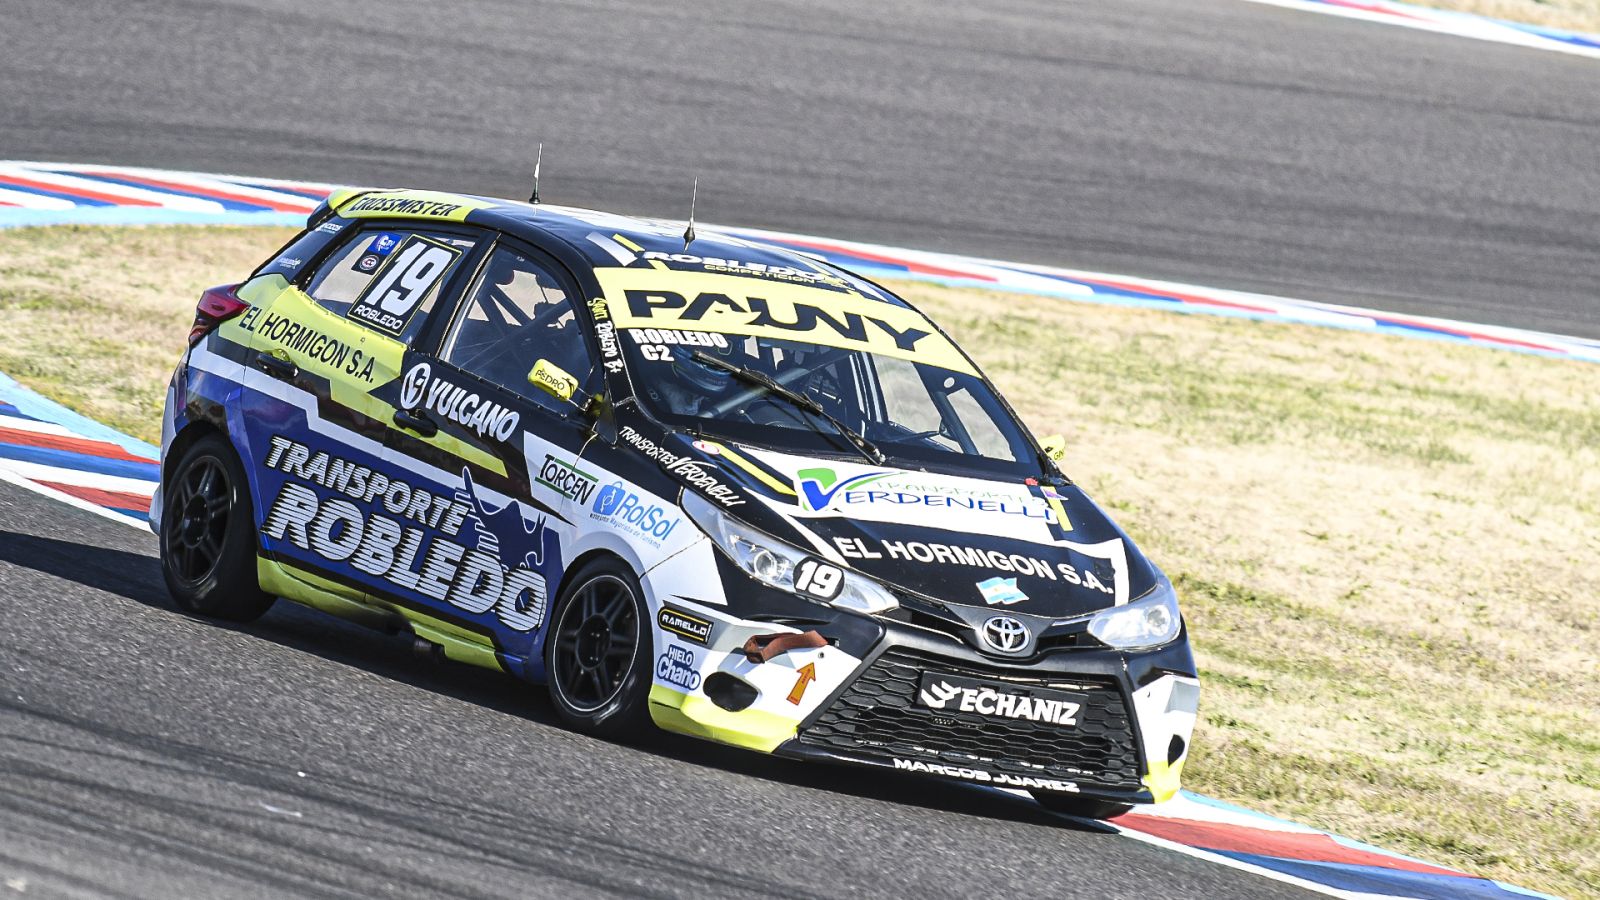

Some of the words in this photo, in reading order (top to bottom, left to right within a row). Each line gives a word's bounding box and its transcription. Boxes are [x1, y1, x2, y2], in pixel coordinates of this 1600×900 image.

[364, 241, 452, 316] 19
[643, 251, 826, 282] ROBLEDO
[704, 263, 816, 284] COMPETICION
[354, 304, 404, 329] ROBLEDO
[622, 288, 933, 352] PAUNY
[238, 306, 263, 332] EL
[258, 312, 350, 369] HORMIGON
[345, 350, 375, 383] S.A.
[628, 328, 729, 348] ROBLEDO
[640, 344, 675, 361] C2
[535, 369, 565, 391] PEDRO
[425, 377, 520, 443] VULCANO
[539, 453, 597, 506] TORCEN
[619, 426, 678, 464] TRANSPORTES
[667, 456, 746, 506] VERDENELLI
[265, 435, 471, 536] TRANSPORTE
[614, 491, 681, 541] RolSol
[260, 481, 548, 631] ROBLEDO
[832, 537, 881, 559] EL
[881, 540, 1058, 581] HORMIGON
[1056, 563, 1114, 594] S.A.
[795, 560, 843, 598] 19
[661, 614, 708, 635] RAMELLO
[657, 654, 701, 690] Chano
[668, 646, 694, 665] HIELO
[959, 687, 1081, 726] ECHANIZ
[893, 757, 992, 781] MARCOS
[992, 773, 1081, 793] JUAREZ
